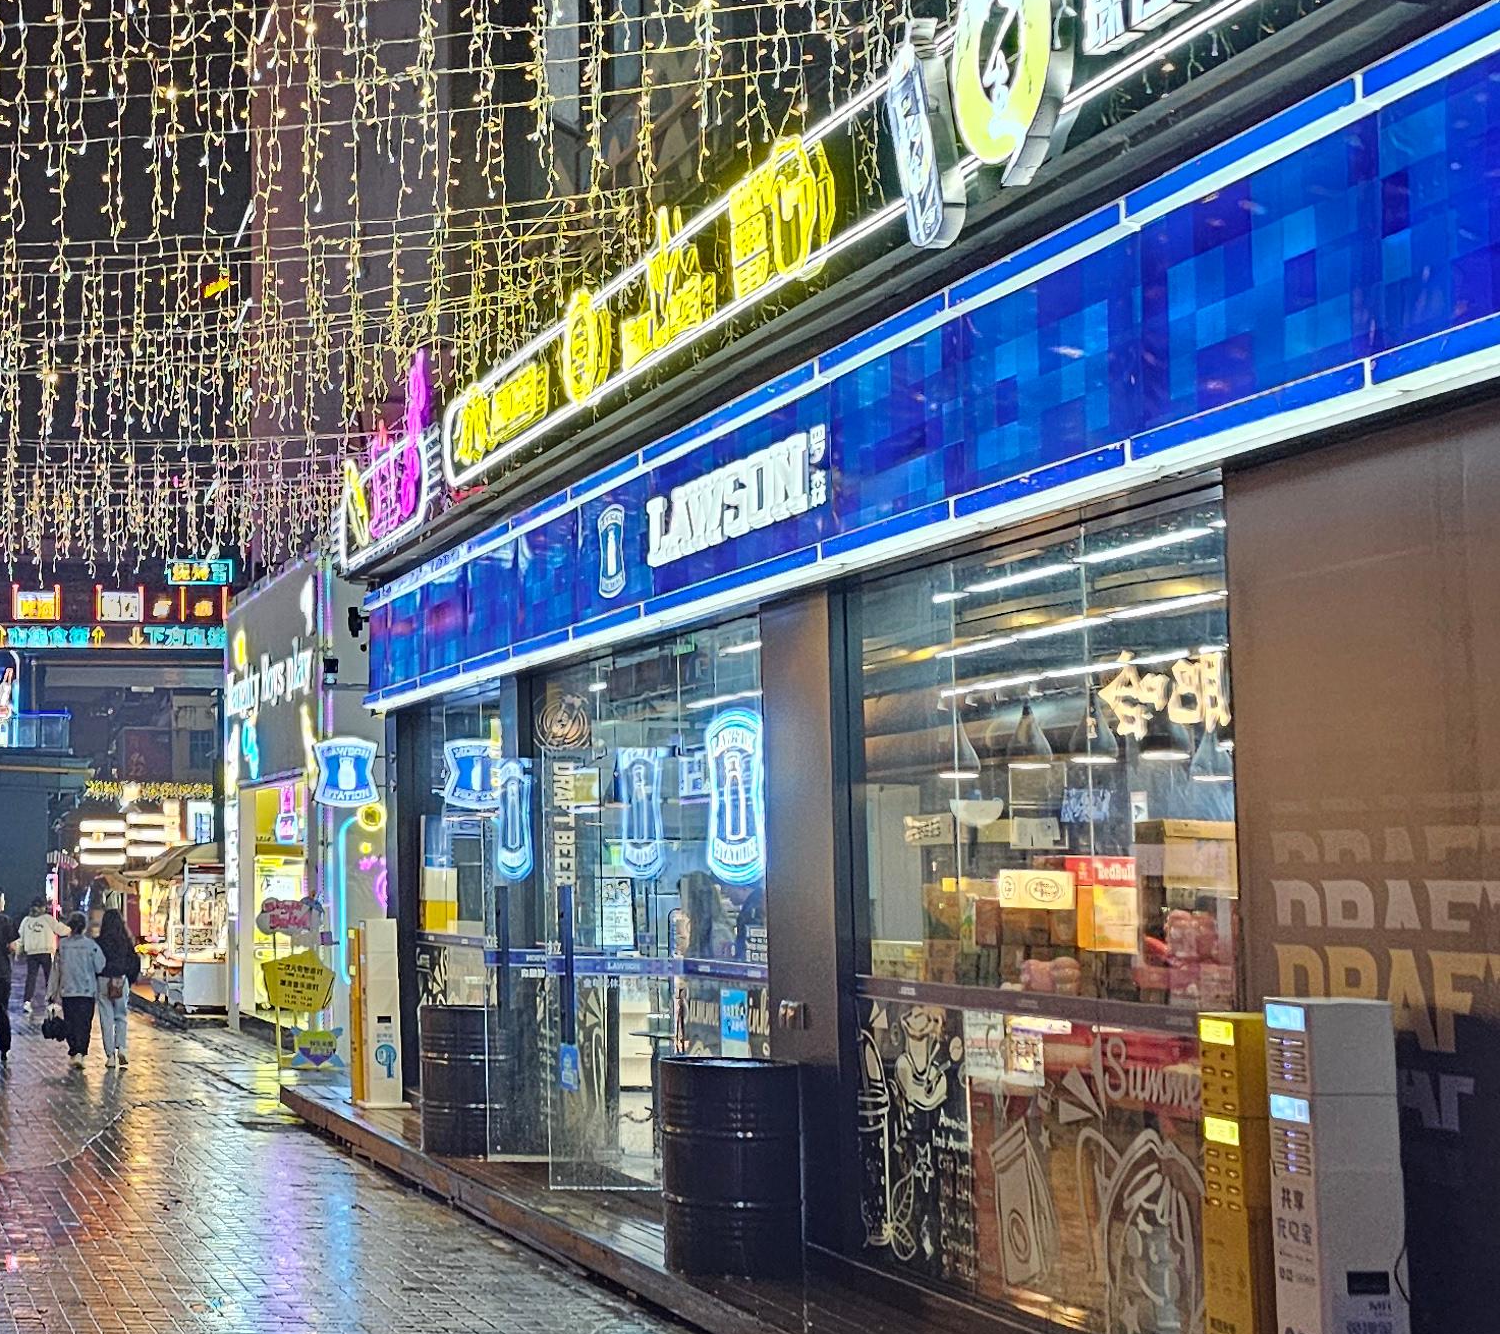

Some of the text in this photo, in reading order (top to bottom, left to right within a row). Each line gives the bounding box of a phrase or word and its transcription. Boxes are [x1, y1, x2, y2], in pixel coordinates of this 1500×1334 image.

[645, 431, 809, 567] LAWSON
[809, 423, 826, 508] 罗森
[322, 786, 373, 801] STATION
[553, 761, 576, 886] DRAFT BEER
[1106, 1036, 1201, 1110] Summe
[1276, 1216, 1313, 1247] 充电宝
[1281, 1186, 1305, 1211] 共享
